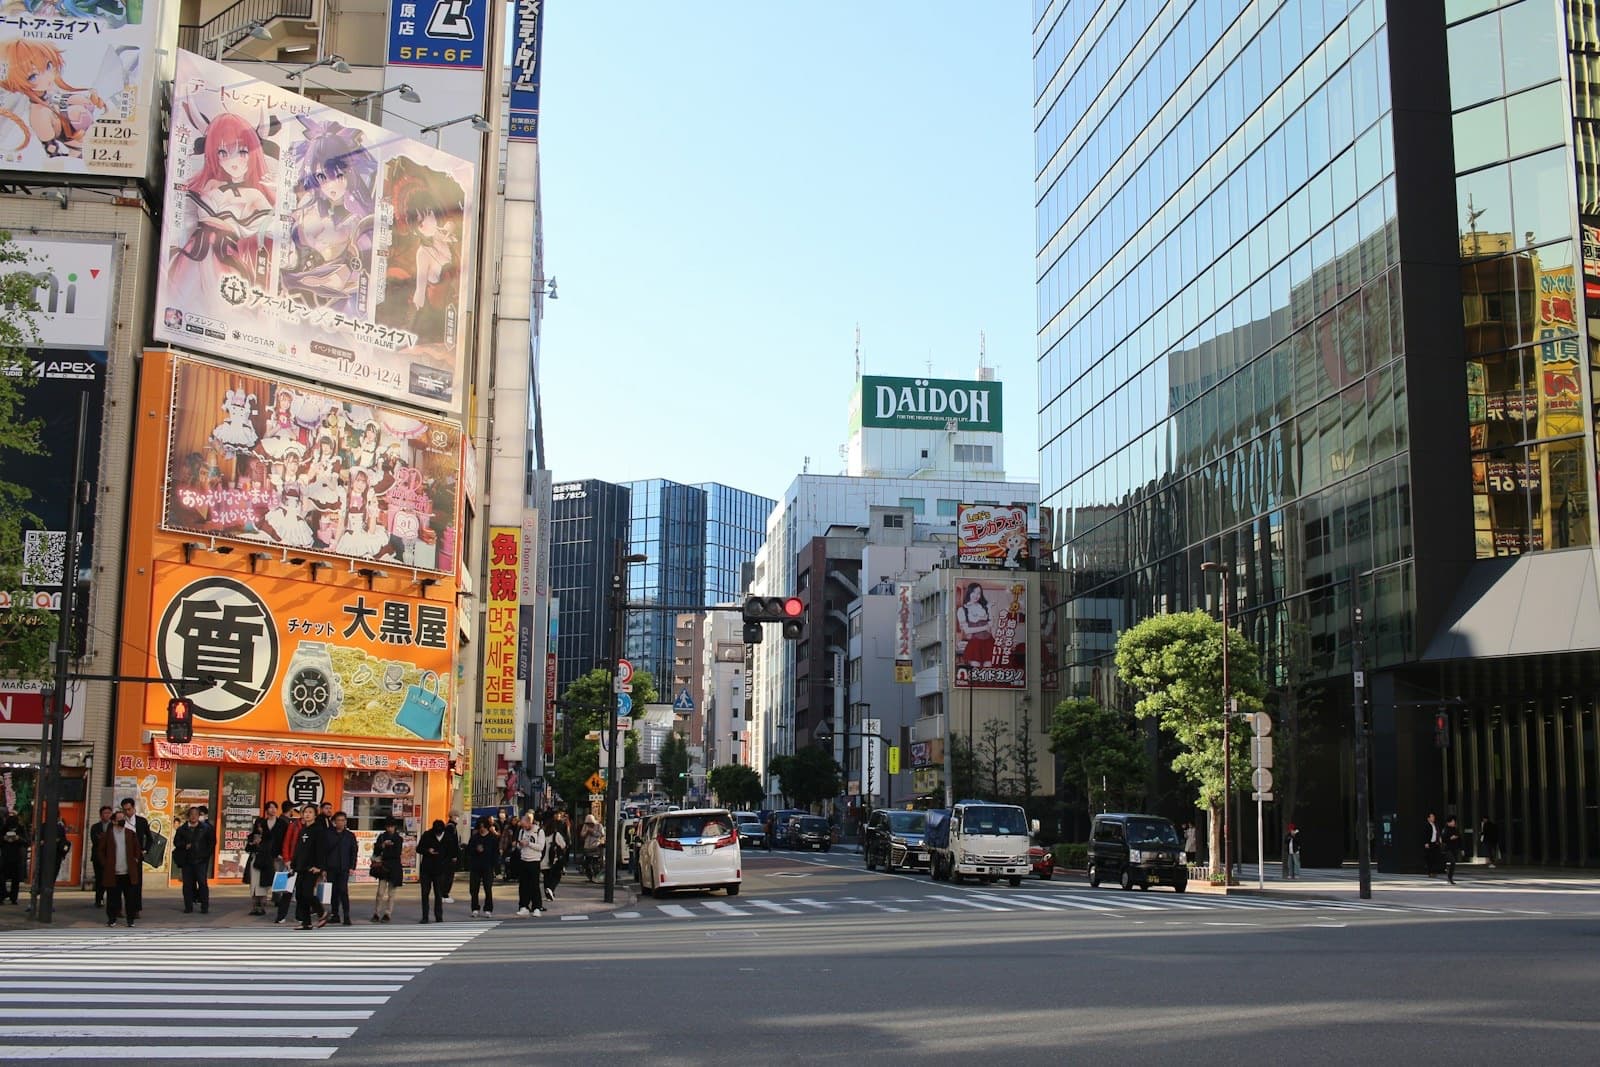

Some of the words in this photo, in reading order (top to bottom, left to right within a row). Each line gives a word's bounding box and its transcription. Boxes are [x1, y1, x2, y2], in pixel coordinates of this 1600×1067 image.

[92, 148, 122, 161] 12.4
[241, 333, 275, 349] YOSTAR
[47, 361, 96, 374] APEX
[491, 533, 518, 601] 免税
[288, 617, 335, 636] チケット
[343, 596, 448, 649] 大黒屋
[503, 608, 516, 646] TAX
[485, 607, 502, 703] 면세점
[501, 653, 515, 703] FREE
[119, 755, 133, 771] 質
[136, 758, 143, 768] &
[146, 757, 172, 772] 買取
